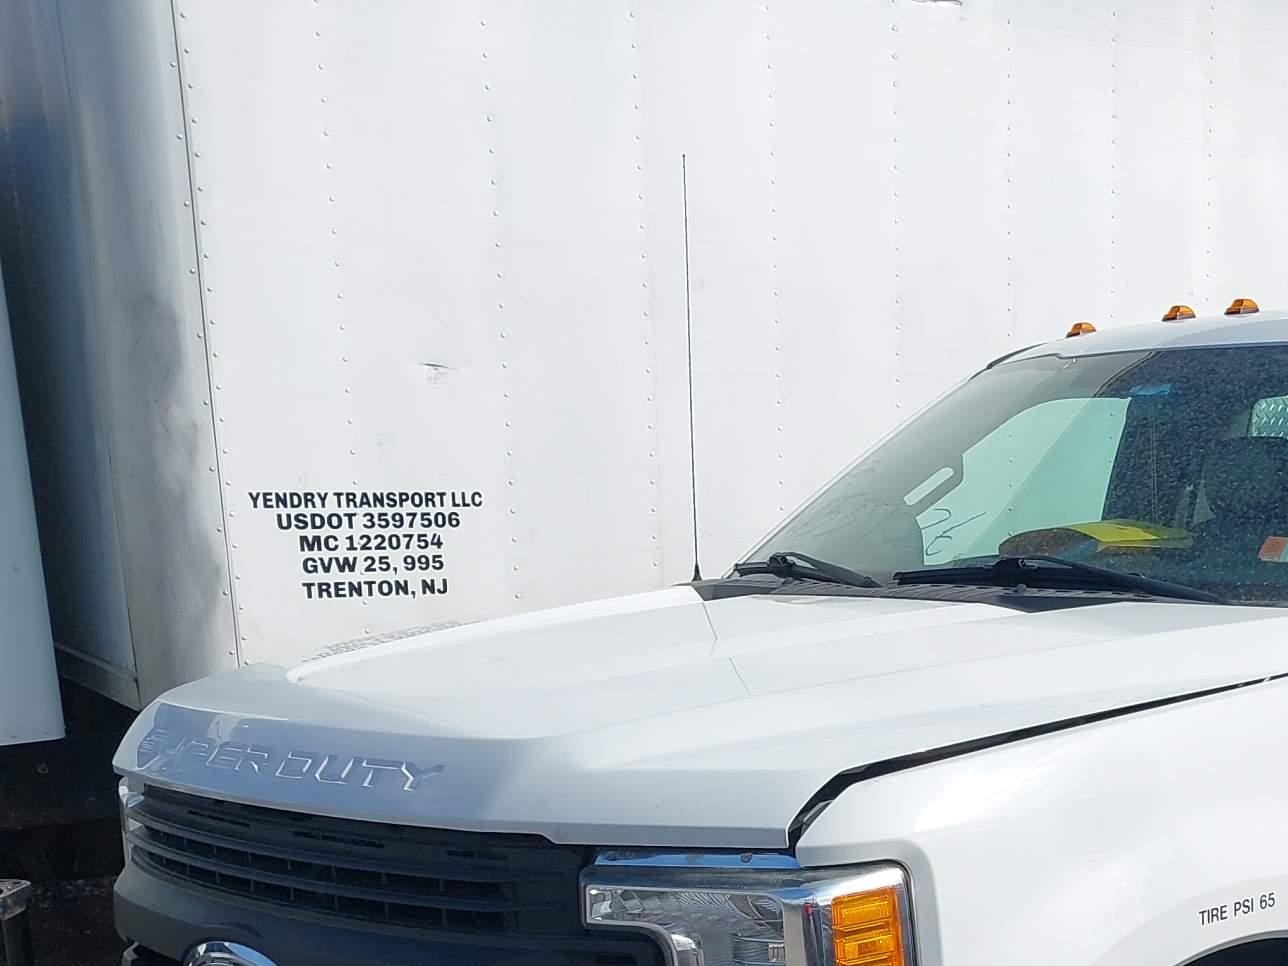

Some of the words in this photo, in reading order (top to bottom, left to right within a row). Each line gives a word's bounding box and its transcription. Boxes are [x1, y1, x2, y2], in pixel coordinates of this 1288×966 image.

[248, 491, 328, 509] YENDRY
[333, 491, 446, 508] TRANSPORT
[451, 491, 482, 508] LLC
[276, 512, 356, 530] USDOT
[362, 511, 461, 529] 3597506
[300, 535, 339, 552] MC
[346, 533, 443, 551] 1220754
[302, 556, 357, 574] GVW
[403, 554, 444, 571] 995
[302, 579, 416, 599] TRENTON,
[421, 578, 448, 595] NJ
[273, 751, 446, 792] DUTY
[1199, 904, 1228, 926] TIRE
[1233, 897, 1254, 917] PSI
[1259, 892, 1276, 910] 65
